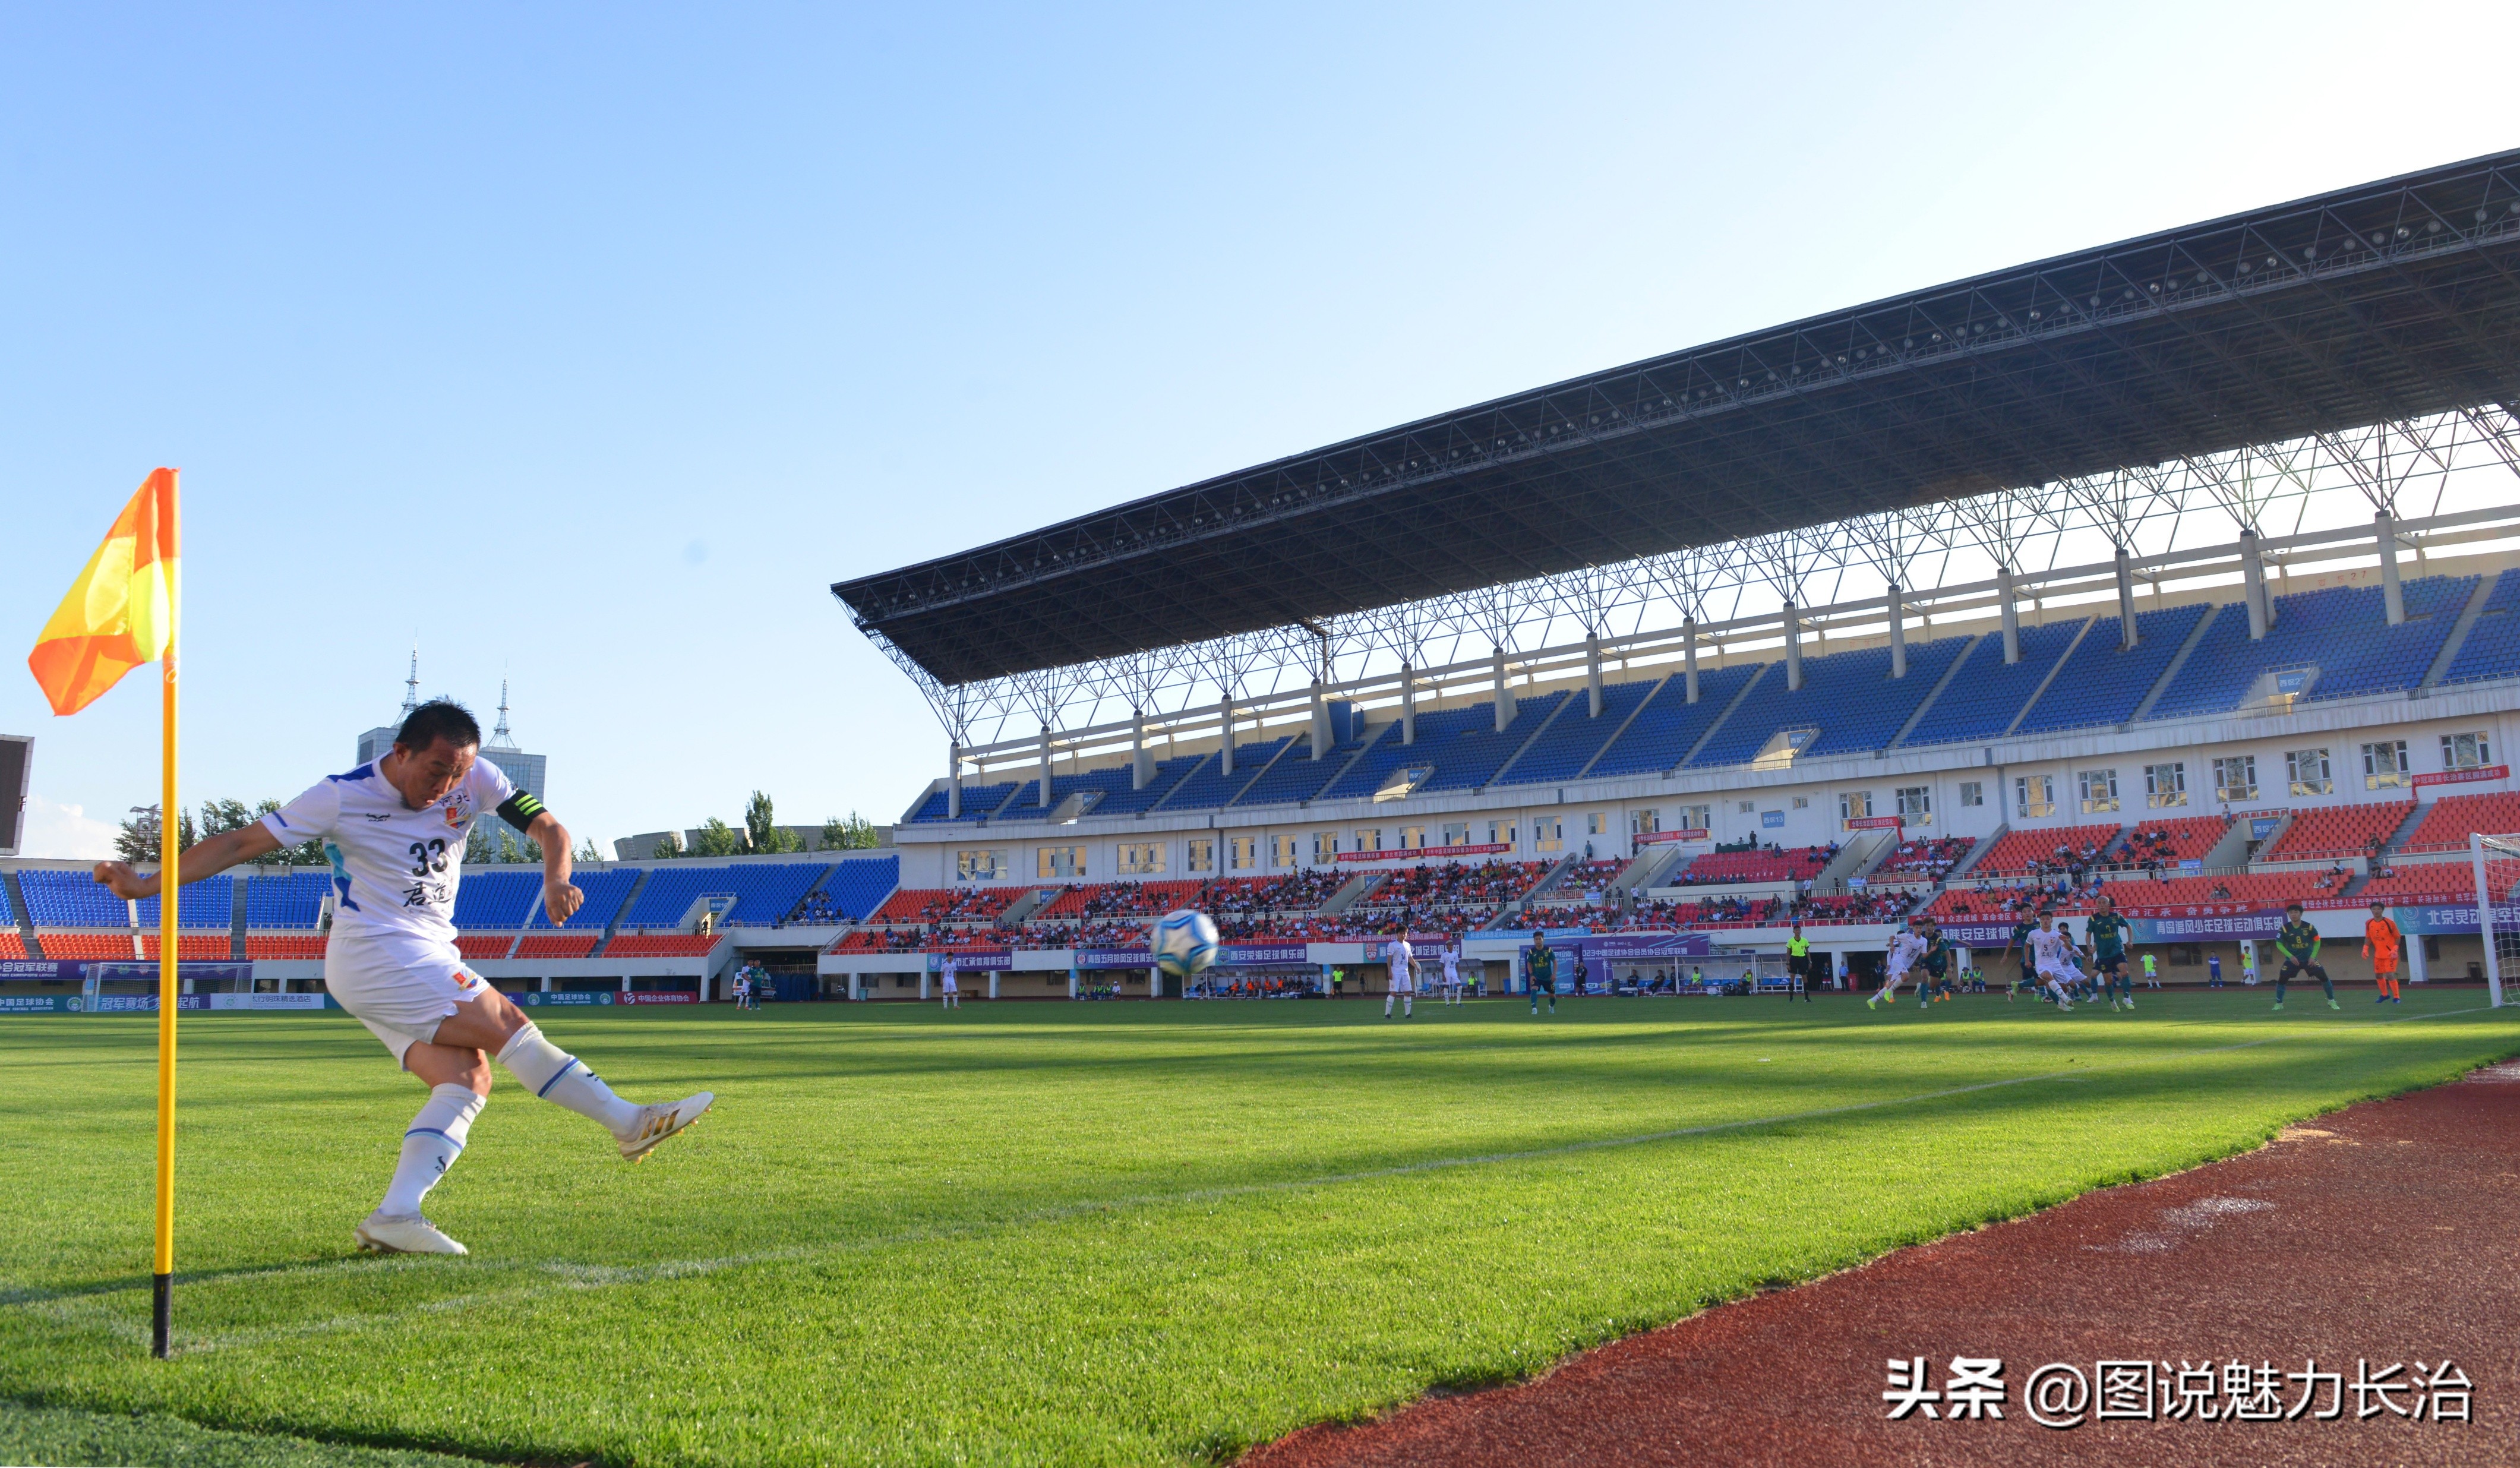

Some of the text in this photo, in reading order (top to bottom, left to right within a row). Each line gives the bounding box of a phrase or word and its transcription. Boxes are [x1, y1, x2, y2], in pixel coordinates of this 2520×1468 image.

[409, 838, 448, 877] 33
[2186, 904, 2248, 915] 奋勇争胜
[1949, 914, 1978, 923] 众志成城
[1982, 913, 2011, 921] 革命老区
[2156, 916, 2283, 935] 青岛追风少年足球运动俱乐部
[1230, 949, 1305, 960] 西安荣海足球俱乐部
[1583, 946, 1688, 956] 023中国足球协会会员协会冠军联赛
[1088, 953, 1158, 963] 青岛五月的风足球俱乐部
[101, 997, 148, 1010] 冠军赛场
